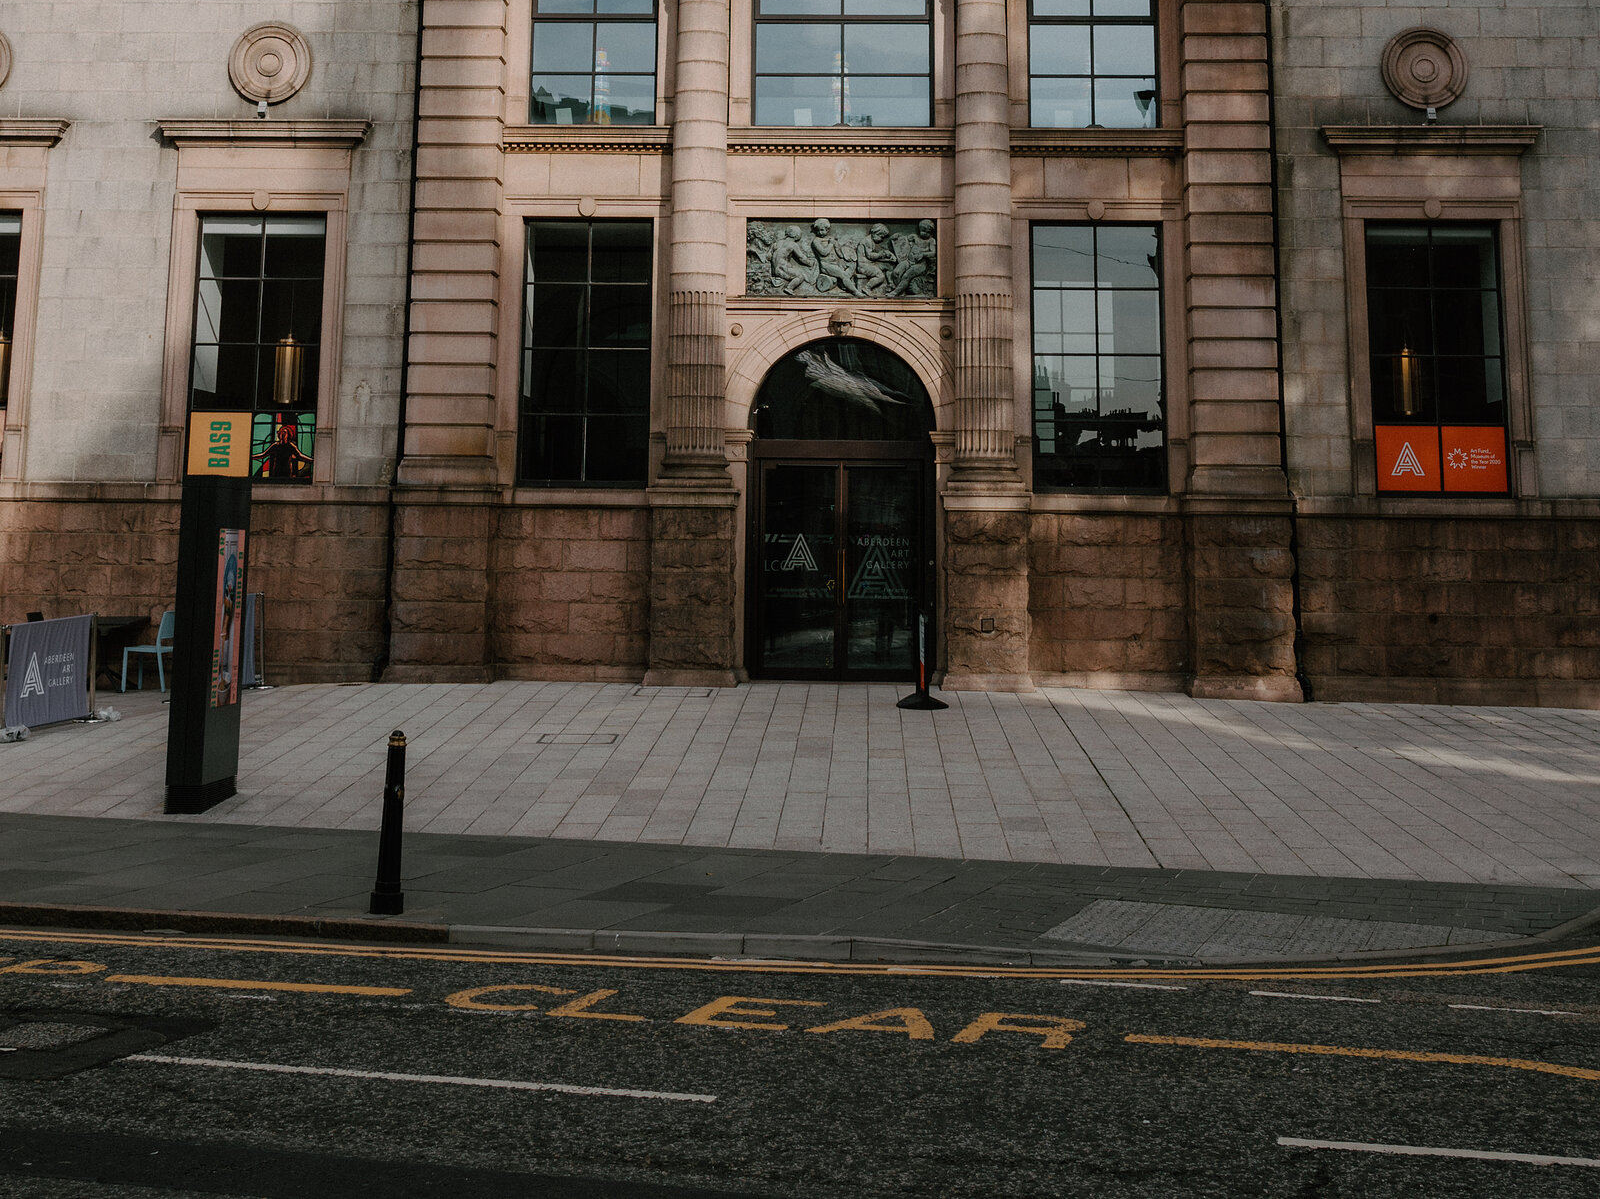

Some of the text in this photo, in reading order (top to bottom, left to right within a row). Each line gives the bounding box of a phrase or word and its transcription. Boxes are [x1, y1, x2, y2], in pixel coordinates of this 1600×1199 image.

[208, 420, 232, 468] BAS9
[857, 538, 910, 547] ABERDEEN
[891, 550, 910, 558] ART
[866, 560, 910, 569] GALLERY
[44, 652, 74, 664] ABERDEEN
[62, 664, 73, 673] ART
[48, 676, 73, 687] GALLERY
[444, 983, 1087, 1049] CLEAR
